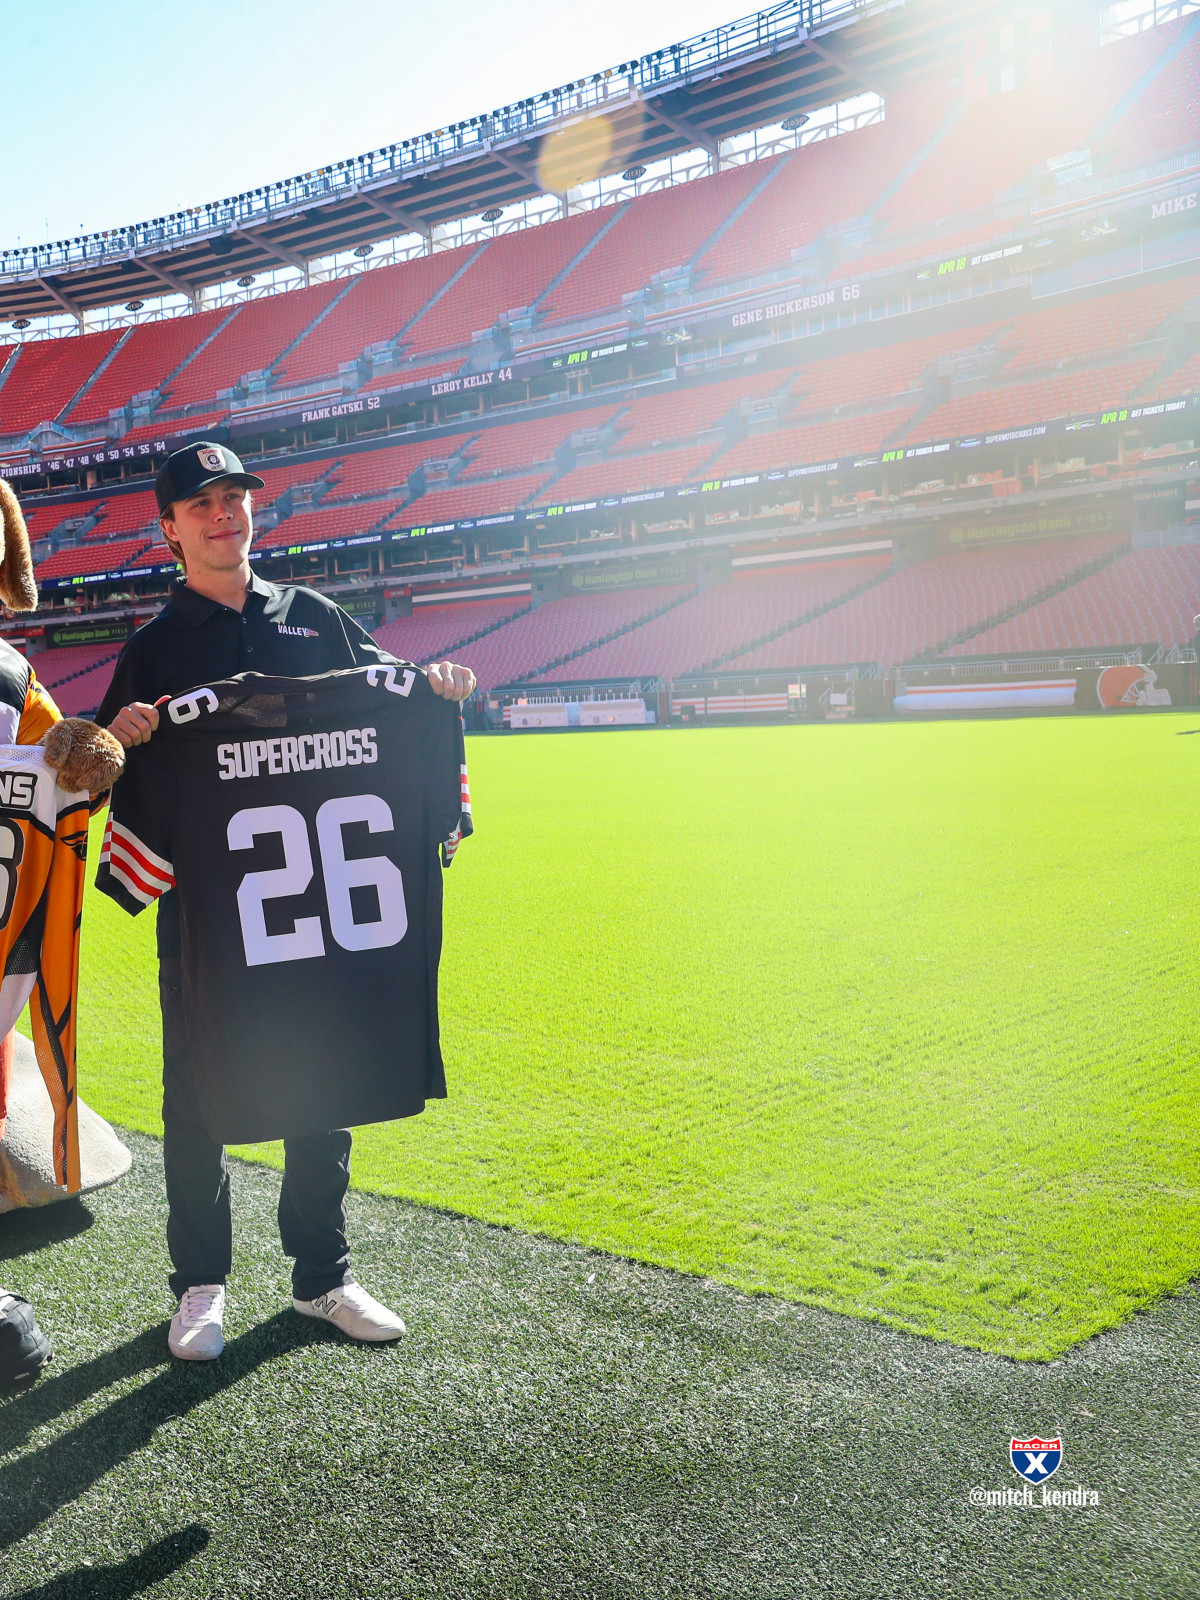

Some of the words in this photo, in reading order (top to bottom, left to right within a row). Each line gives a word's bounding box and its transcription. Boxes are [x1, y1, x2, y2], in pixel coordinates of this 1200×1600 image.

[1151, 192, 1198, 219] MIKE
[937, 259, 955, 276] APR
[955, 256, 966, 271] 18
[732, 308, 763, 327] GENE
[766, 290, 835, 320] HICKERSON
[842, 284, 860, 301] 66
[567, 351, 580, 365] APR
[580, 350, 588, 362] 18
[431, 380, 461, 396] LEROY
[463, 371, 493, 389] KELLY
[498, 367, 513, 381] 44
[301, 407, 330, 423] FRANK
[332, 400, 364, 418] GATSKI
[367, 396, 380, 409] 52
[1100, 411, 1118, 425] APR
[1118, 409, 1128, 421] 18
[47, 461, 60, 471] '46
[63, 458, 75, 469] '47
[77, 456, 89, 466] '48
[92, 454, 104, 463] '49
[107, 450, 119, 460] '50
[122, 447, 135, 457] '54
[585, 570, 634, 585] Huntington
[61, 631, 95, 642] Huntington
[95, 629, 110, 638] Bank
[277, 624, 307, 637] VALLEY
[216, 727, 378, 780] SUPERCROSS
[226, 794, 408, 966] 26
